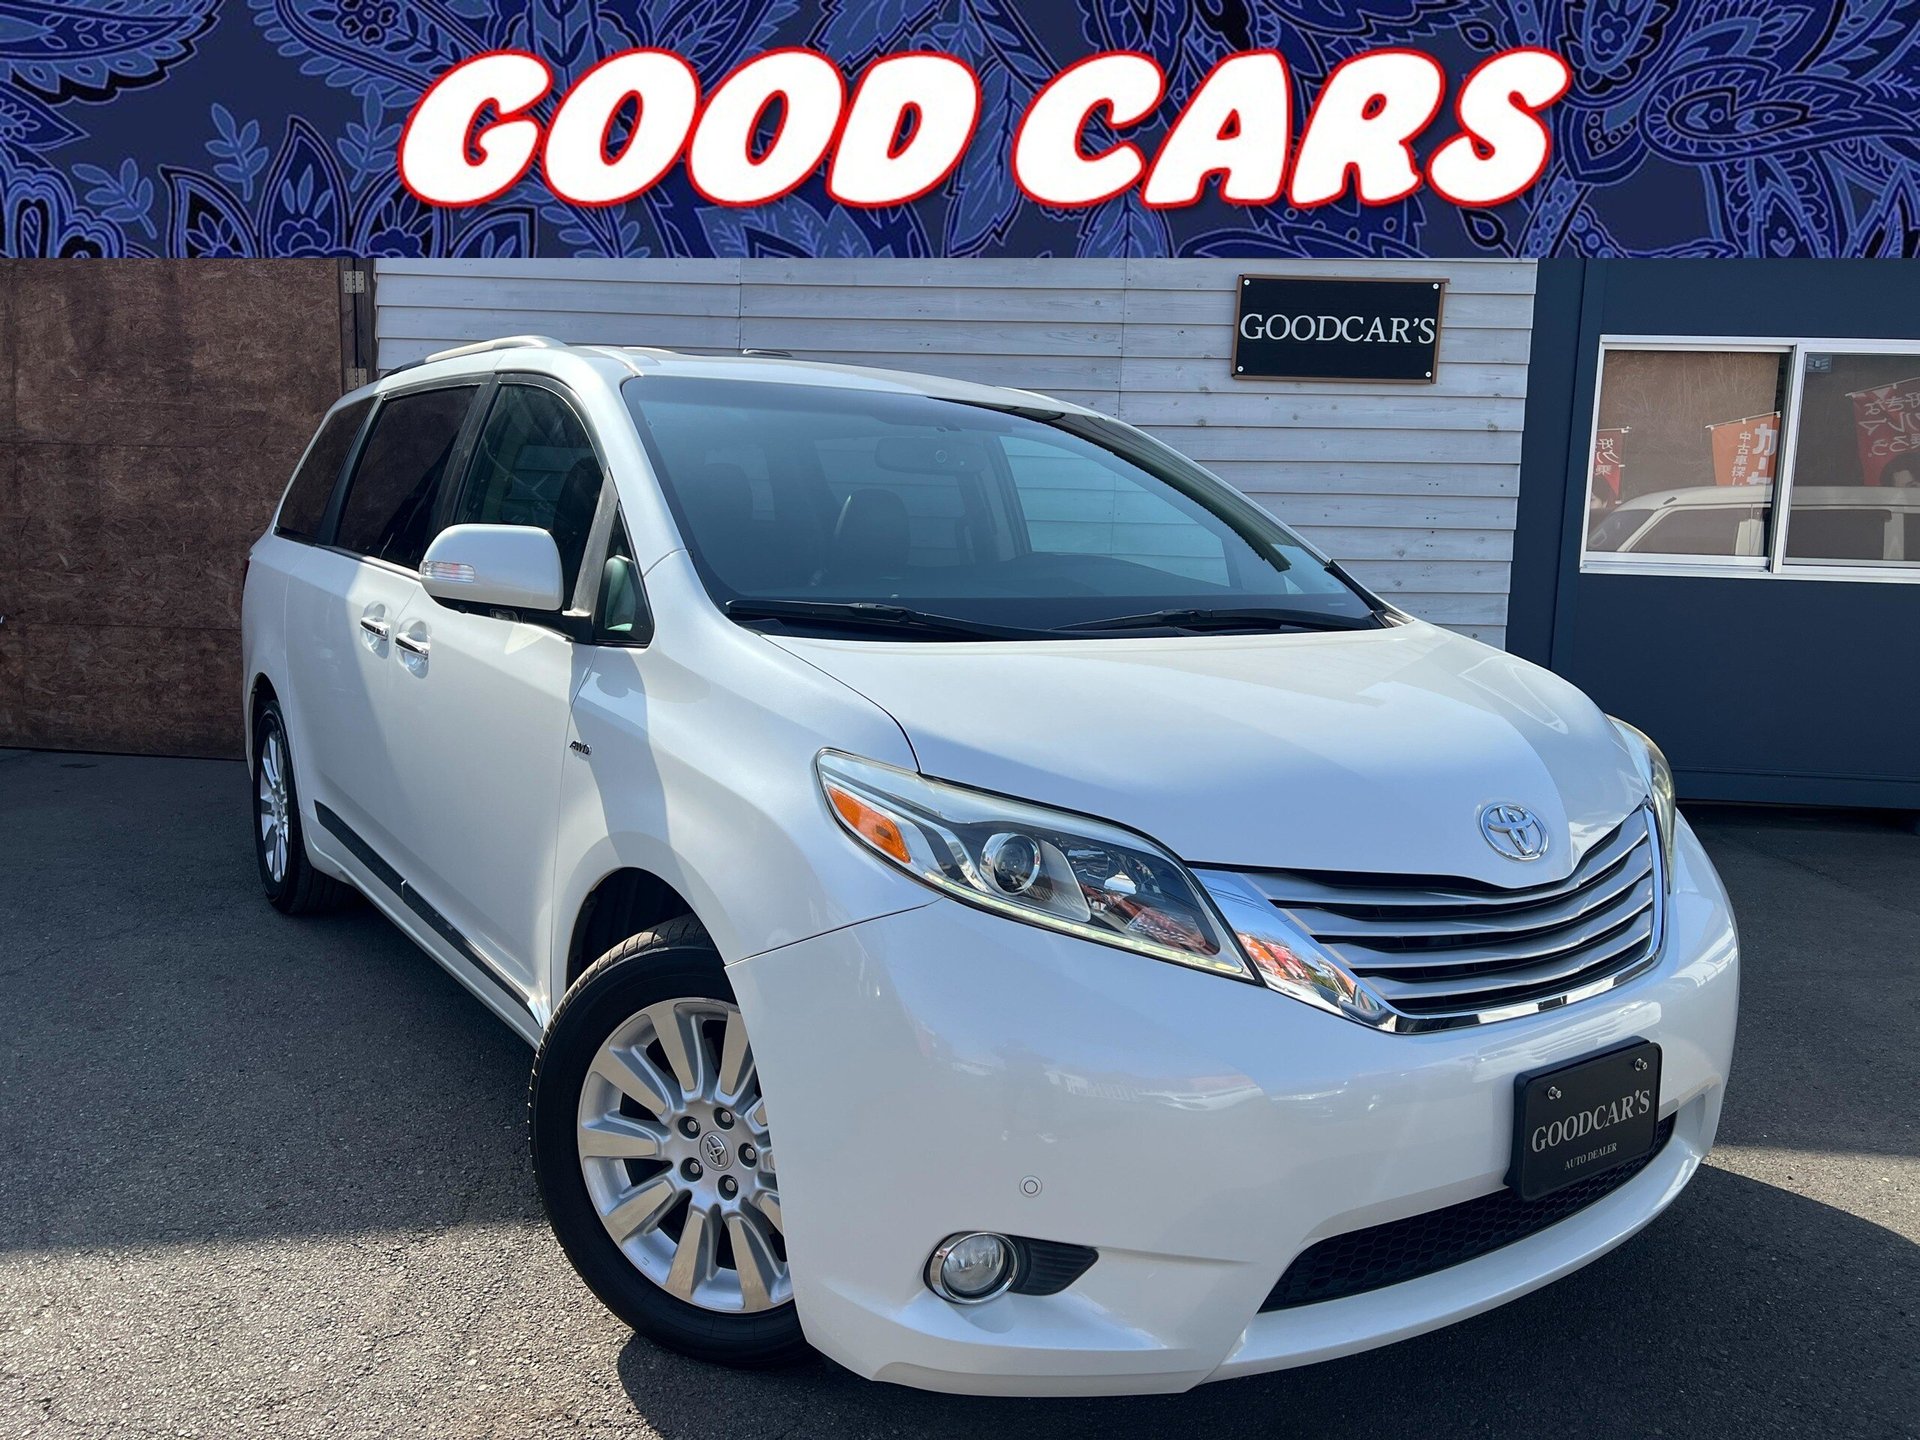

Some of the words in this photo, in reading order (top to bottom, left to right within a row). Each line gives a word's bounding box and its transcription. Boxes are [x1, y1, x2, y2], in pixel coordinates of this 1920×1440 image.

[1239, 313, 1436, 345] GOODCAR'S
[569, 740, 592, 756] AWD
[1531, 1089, 1651, 1153] GOODCAR'S
[1564, 1153, 1587, 1171] AUTO
[1587, 1142, 1617, 1162] DEALER
